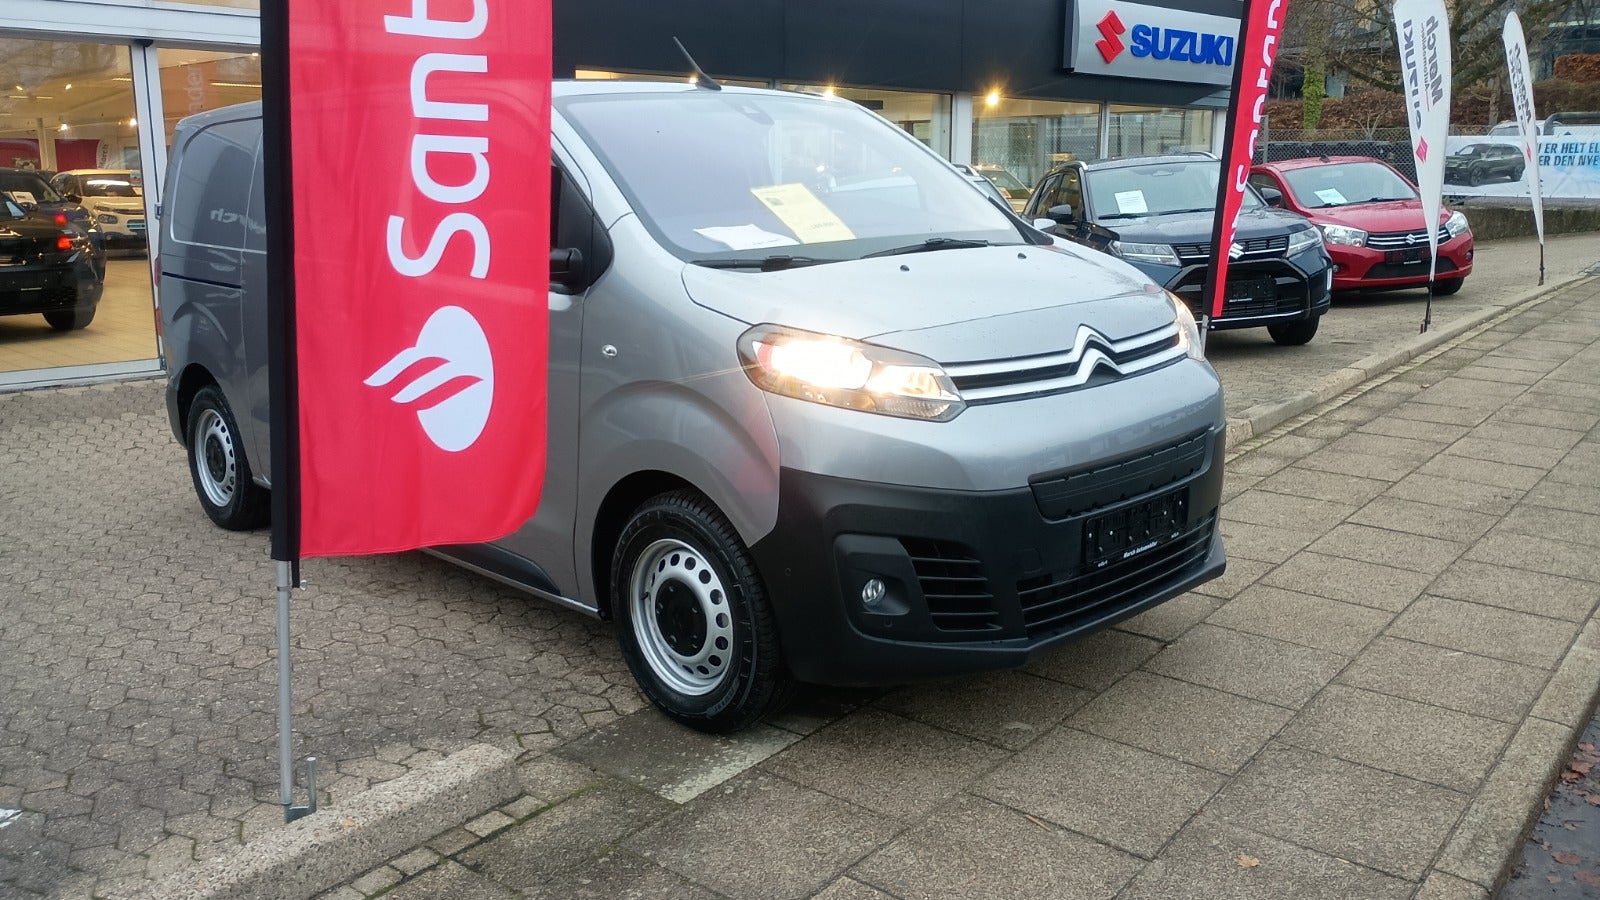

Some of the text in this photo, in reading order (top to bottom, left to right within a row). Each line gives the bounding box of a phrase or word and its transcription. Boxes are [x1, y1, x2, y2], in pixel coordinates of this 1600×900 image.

[1130, 24, 1234, 66] SUZUKI
[1544, 143, 1558, 154] ER
[1561, 143, 1586, 154] HELT
[1539, 155, 1600, 166] ER DEN NYE
